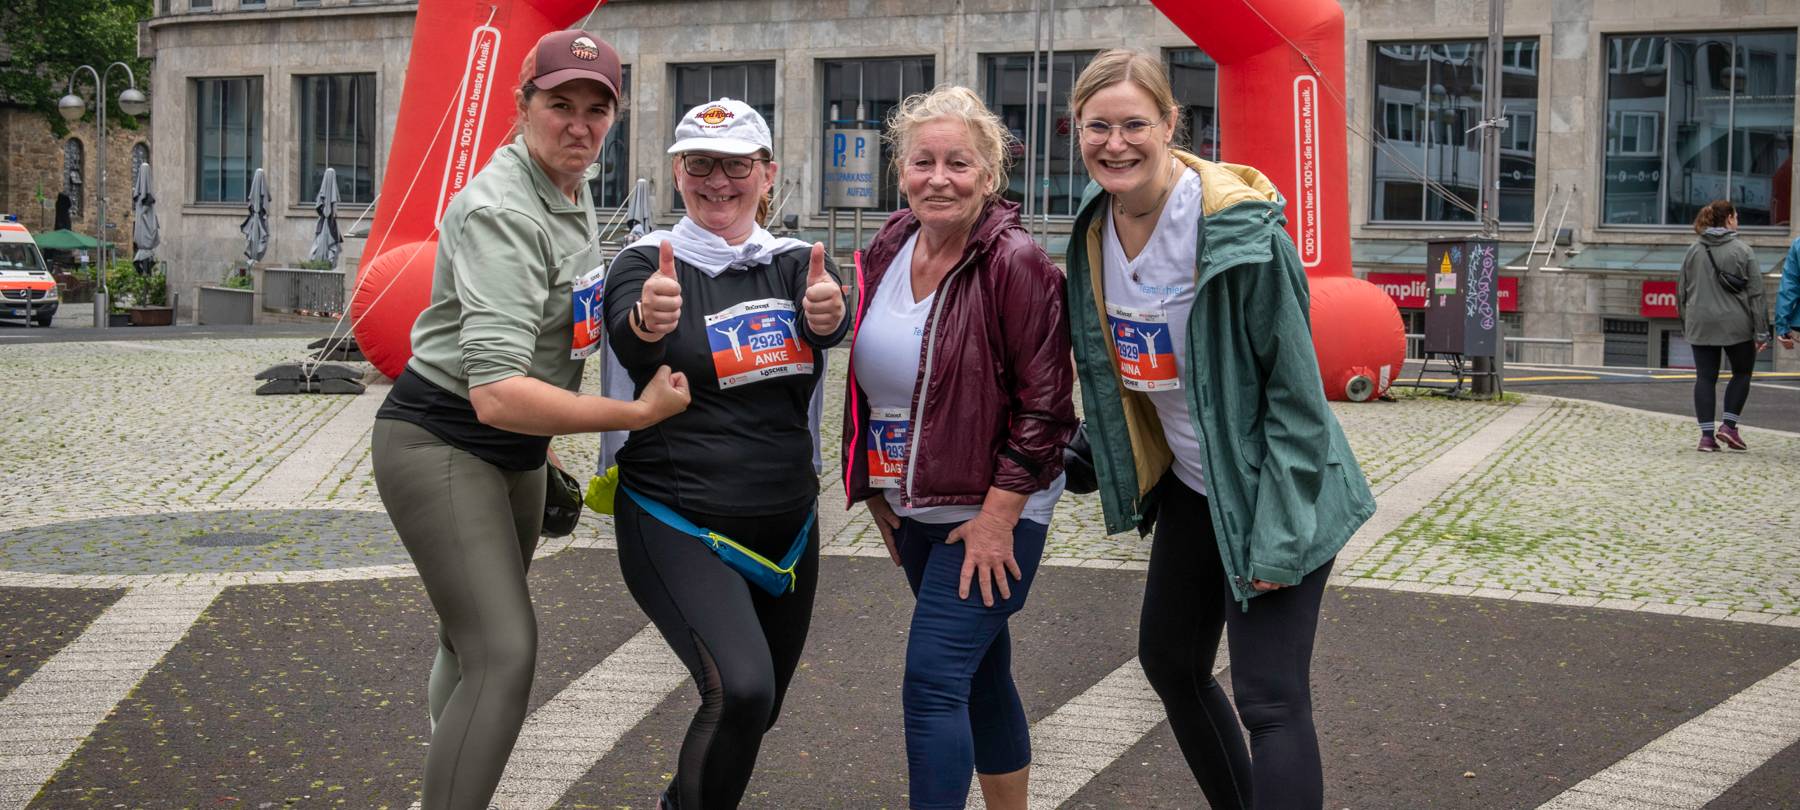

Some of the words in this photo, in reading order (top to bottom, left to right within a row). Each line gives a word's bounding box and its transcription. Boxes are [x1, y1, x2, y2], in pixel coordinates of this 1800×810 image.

[476, 39, 492, 71] Musik.
[470, 72, 484, 101] beste
[467, 102, 478, 117] die
[1302, 86, 1311, 117] Musik.
[694, 110, 715, 119] Hard
[715, 110, 735, 119] Rock
[460, 118, 475, 147] 100%
[1304, 118, 1312, 144] beste
[455, 149, 469, 170] hier.
[1304, 145, 1312, 159] die
[453, 171, 464, 189] von
[1304, 160, 1313, 188] 100%
[1305, 189, 1314, 209] hier.
[1305, 228, 1314, 256] 100%
[750, 333, 784, 350] 2928
[755, 350, 789, 366] ANKE
